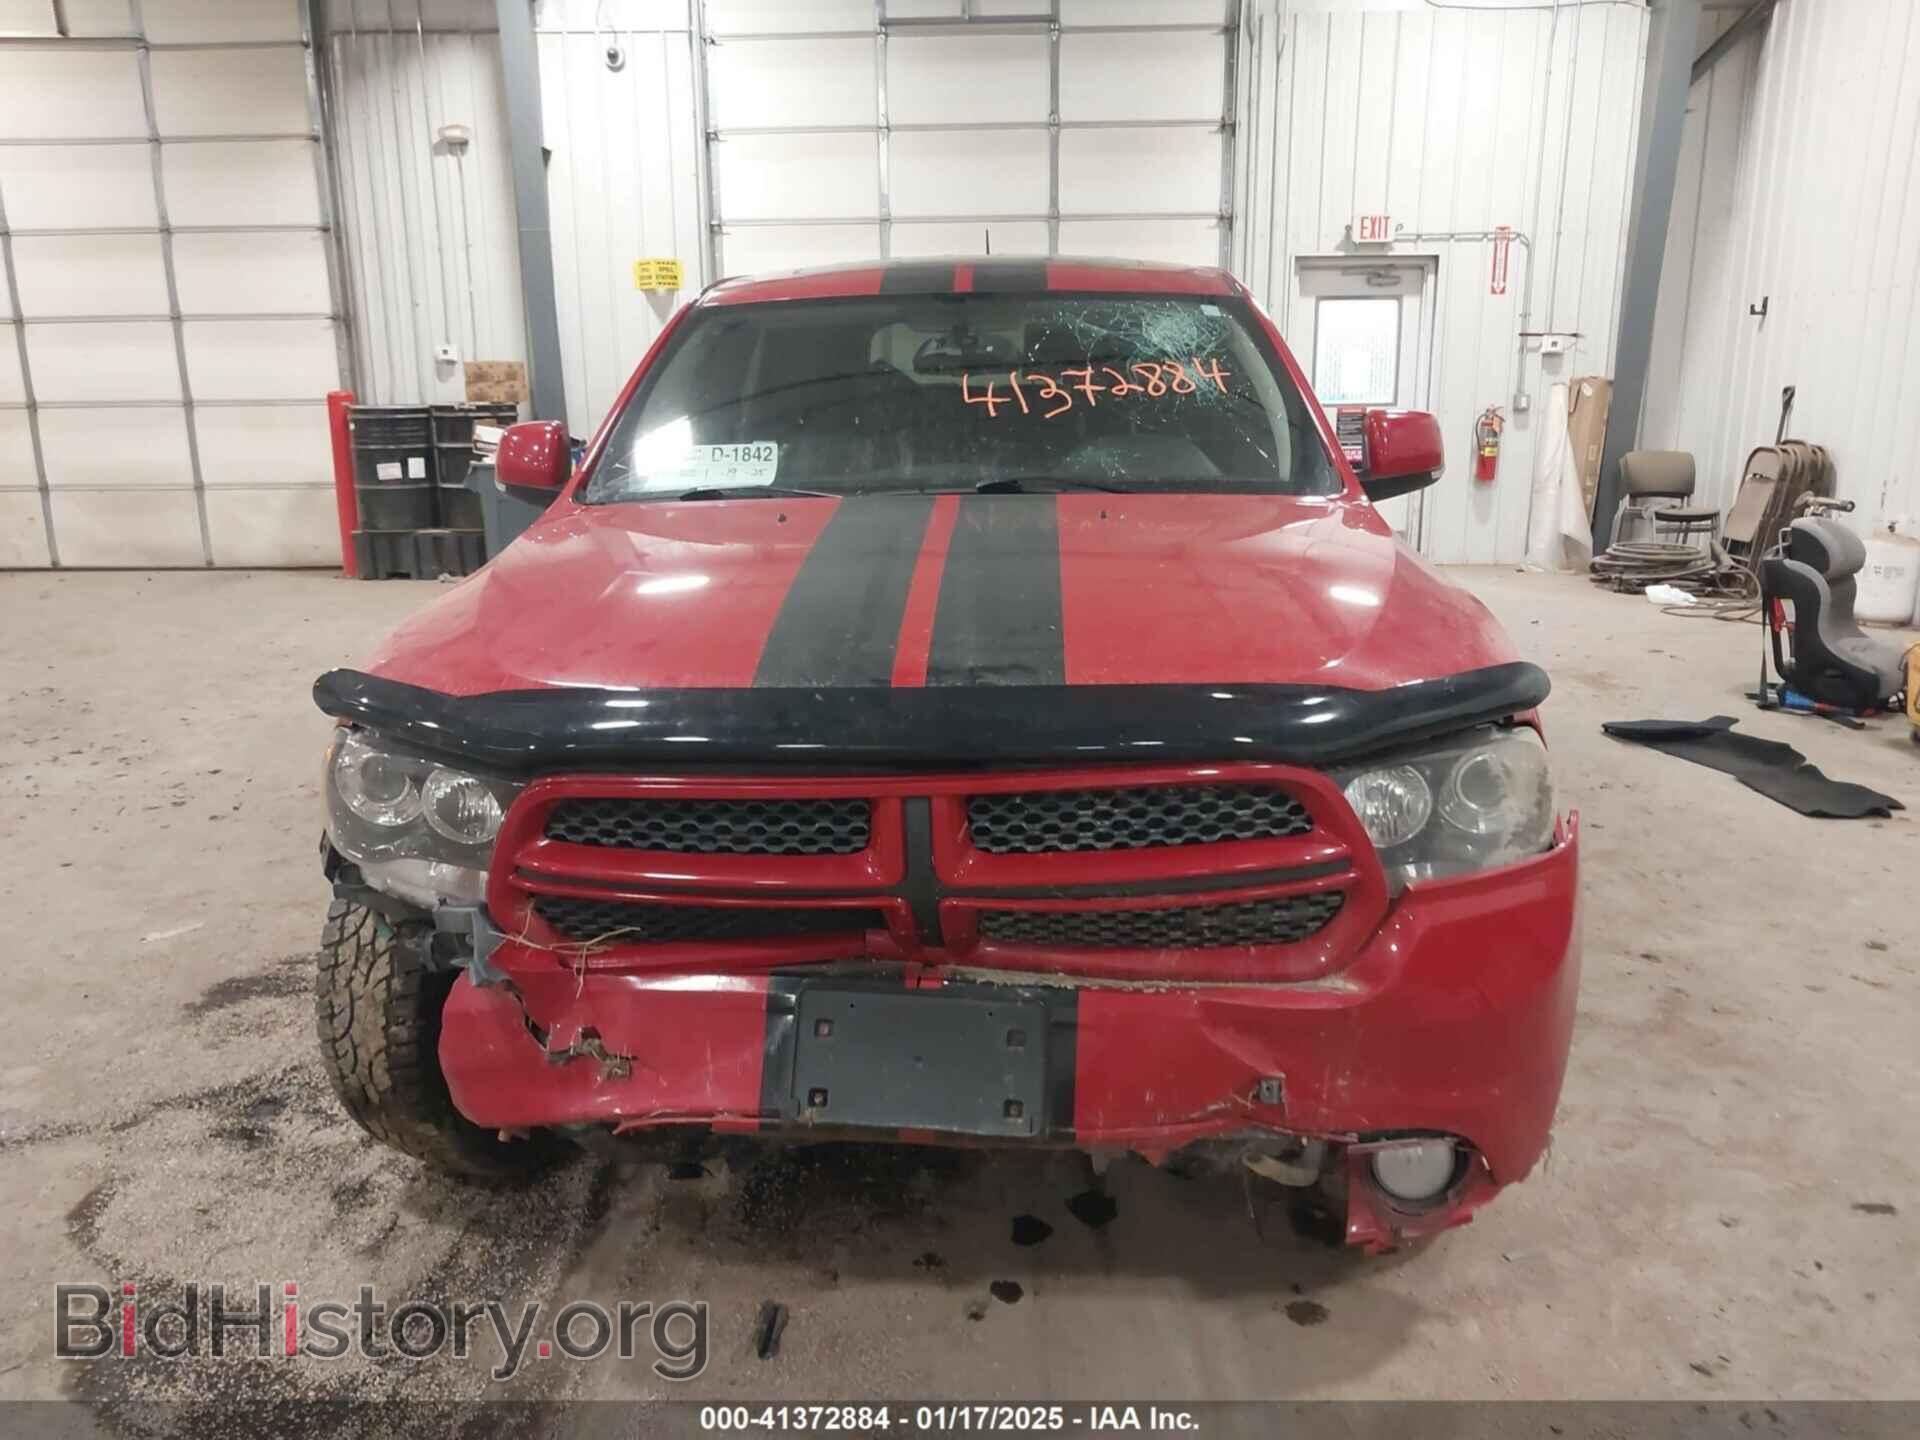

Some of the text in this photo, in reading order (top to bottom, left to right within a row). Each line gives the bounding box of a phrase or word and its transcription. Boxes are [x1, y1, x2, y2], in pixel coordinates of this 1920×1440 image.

[1360, 216, 1390, 240] EXIT
[963, 357, 1231, 418] 41372884
[711, 446, 773, 463] D-1842
